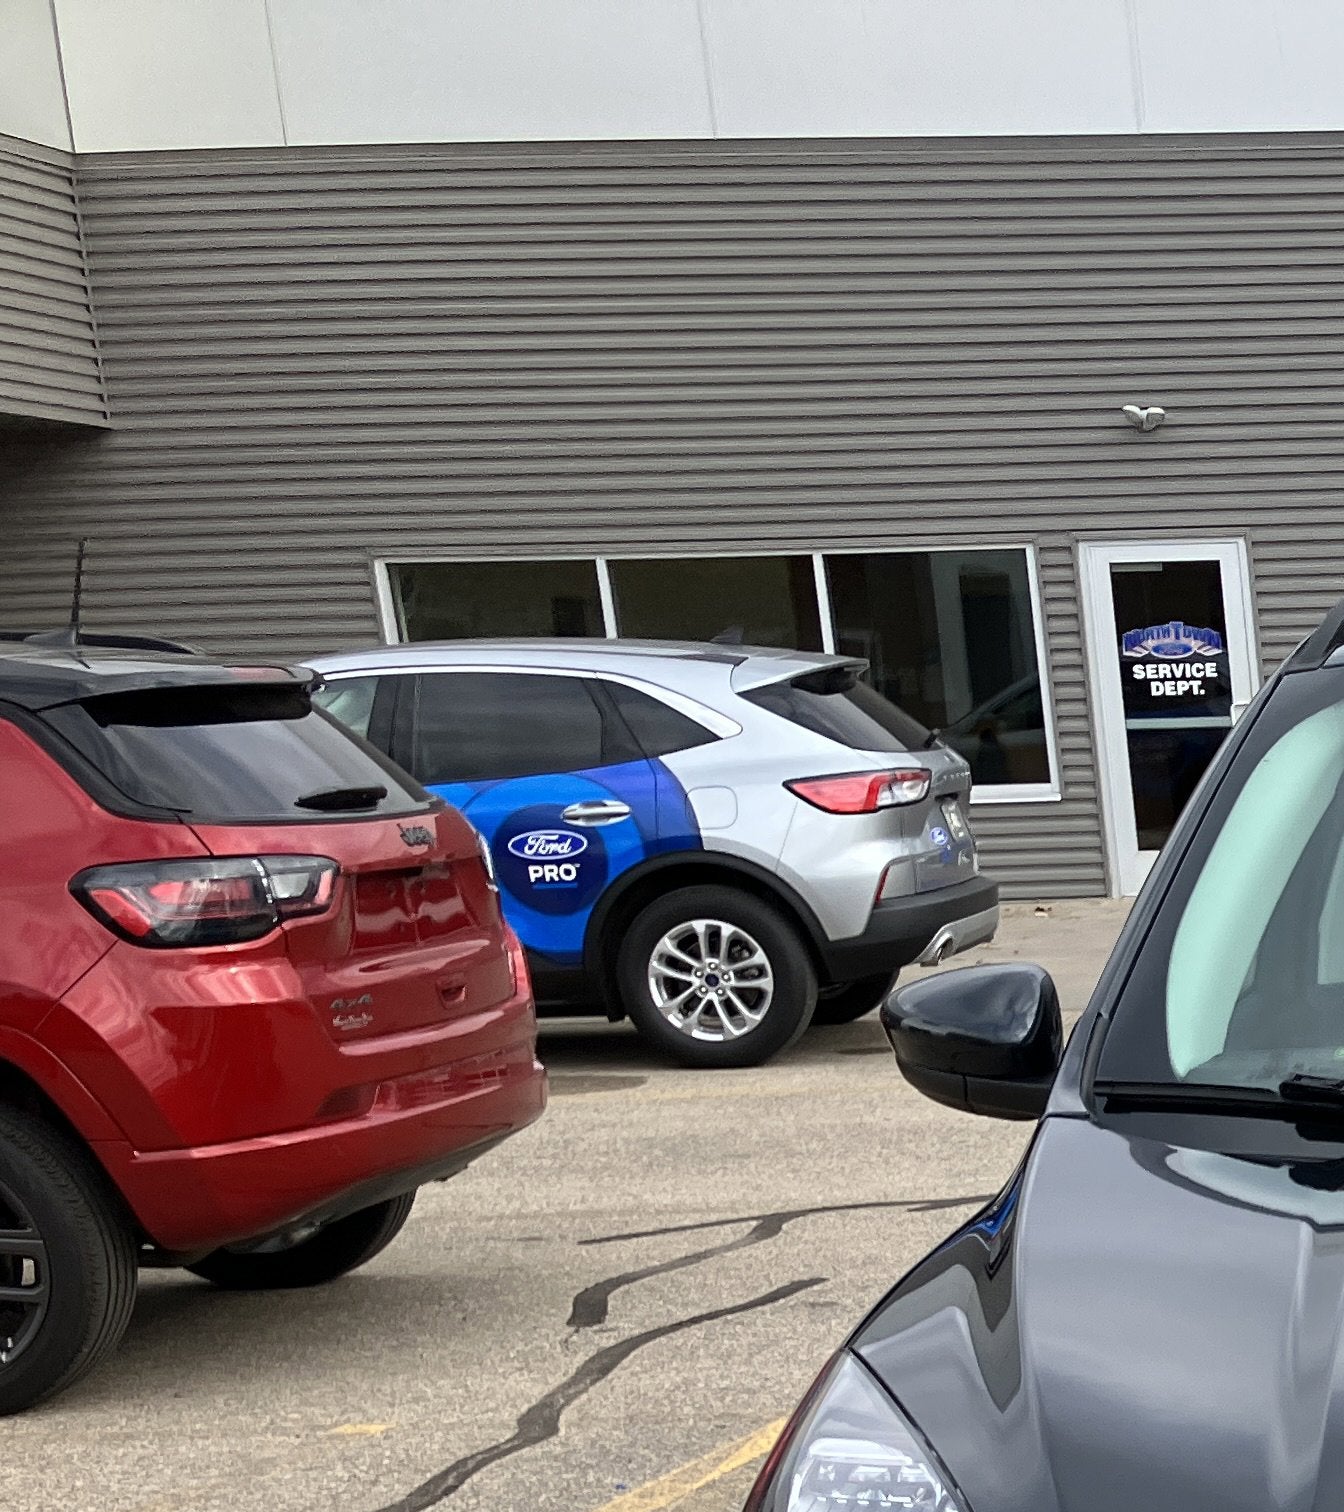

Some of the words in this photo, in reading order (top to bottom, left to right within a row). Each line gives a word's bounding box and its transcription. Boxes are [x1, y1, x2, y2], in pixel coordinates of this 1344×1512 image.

[1132, 662, 1218, 680] SERVICE
[1151, 680, 1206, 697] DEPT.
[524, 834, 573, 855] Ford
[528, 863, 577, 882] PRO
